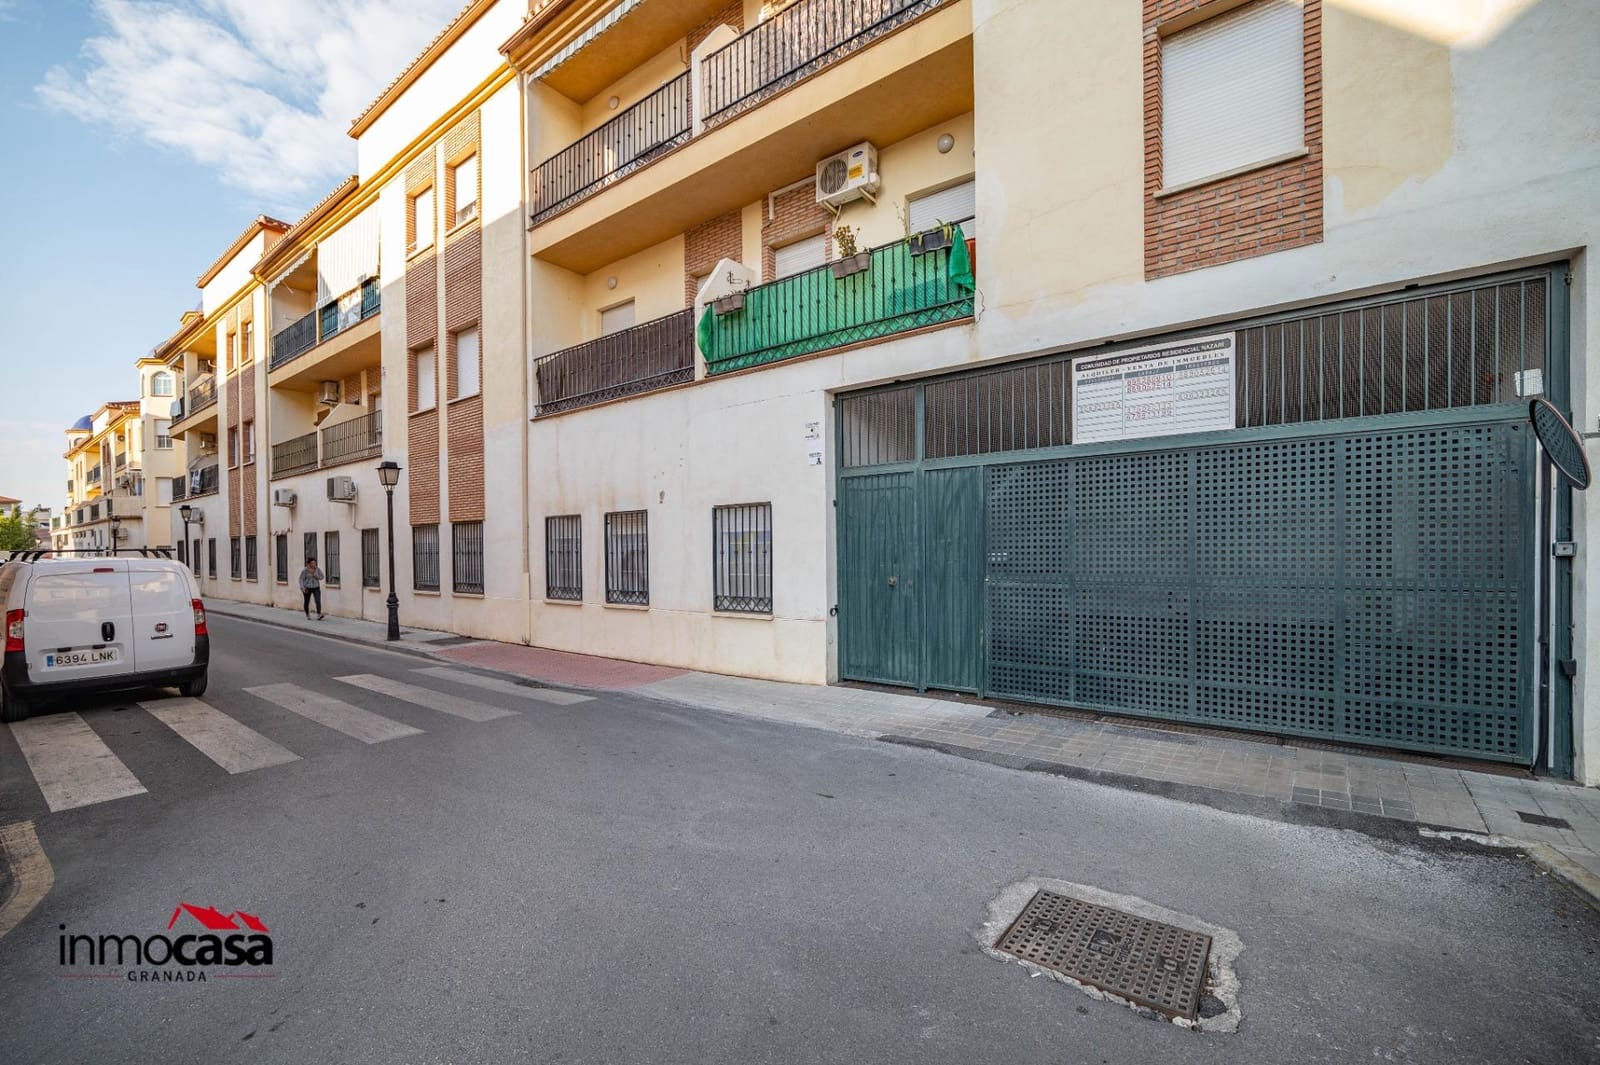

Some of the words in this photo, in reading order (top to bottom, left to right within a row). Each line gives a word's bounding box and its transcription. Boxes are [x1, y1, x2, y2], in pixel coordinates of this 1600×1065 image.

[1080, 361, 1110, 370] COMUNIDAD
[1121, 352, 1161, 364] PROPIETARIOS
[1162, 346, 1199, 357] RESIDENCIAL
[1081, 367, 1119, 378] ALQUILER
[1127, 362, 1153, 371] VENTA
[1157, 360, 1168, 368] DE
[1172, 352, 1225, 365] INMUEBLES
[56, 654, 87, 665] 6394
[91, 651, 114, 662] LNK
